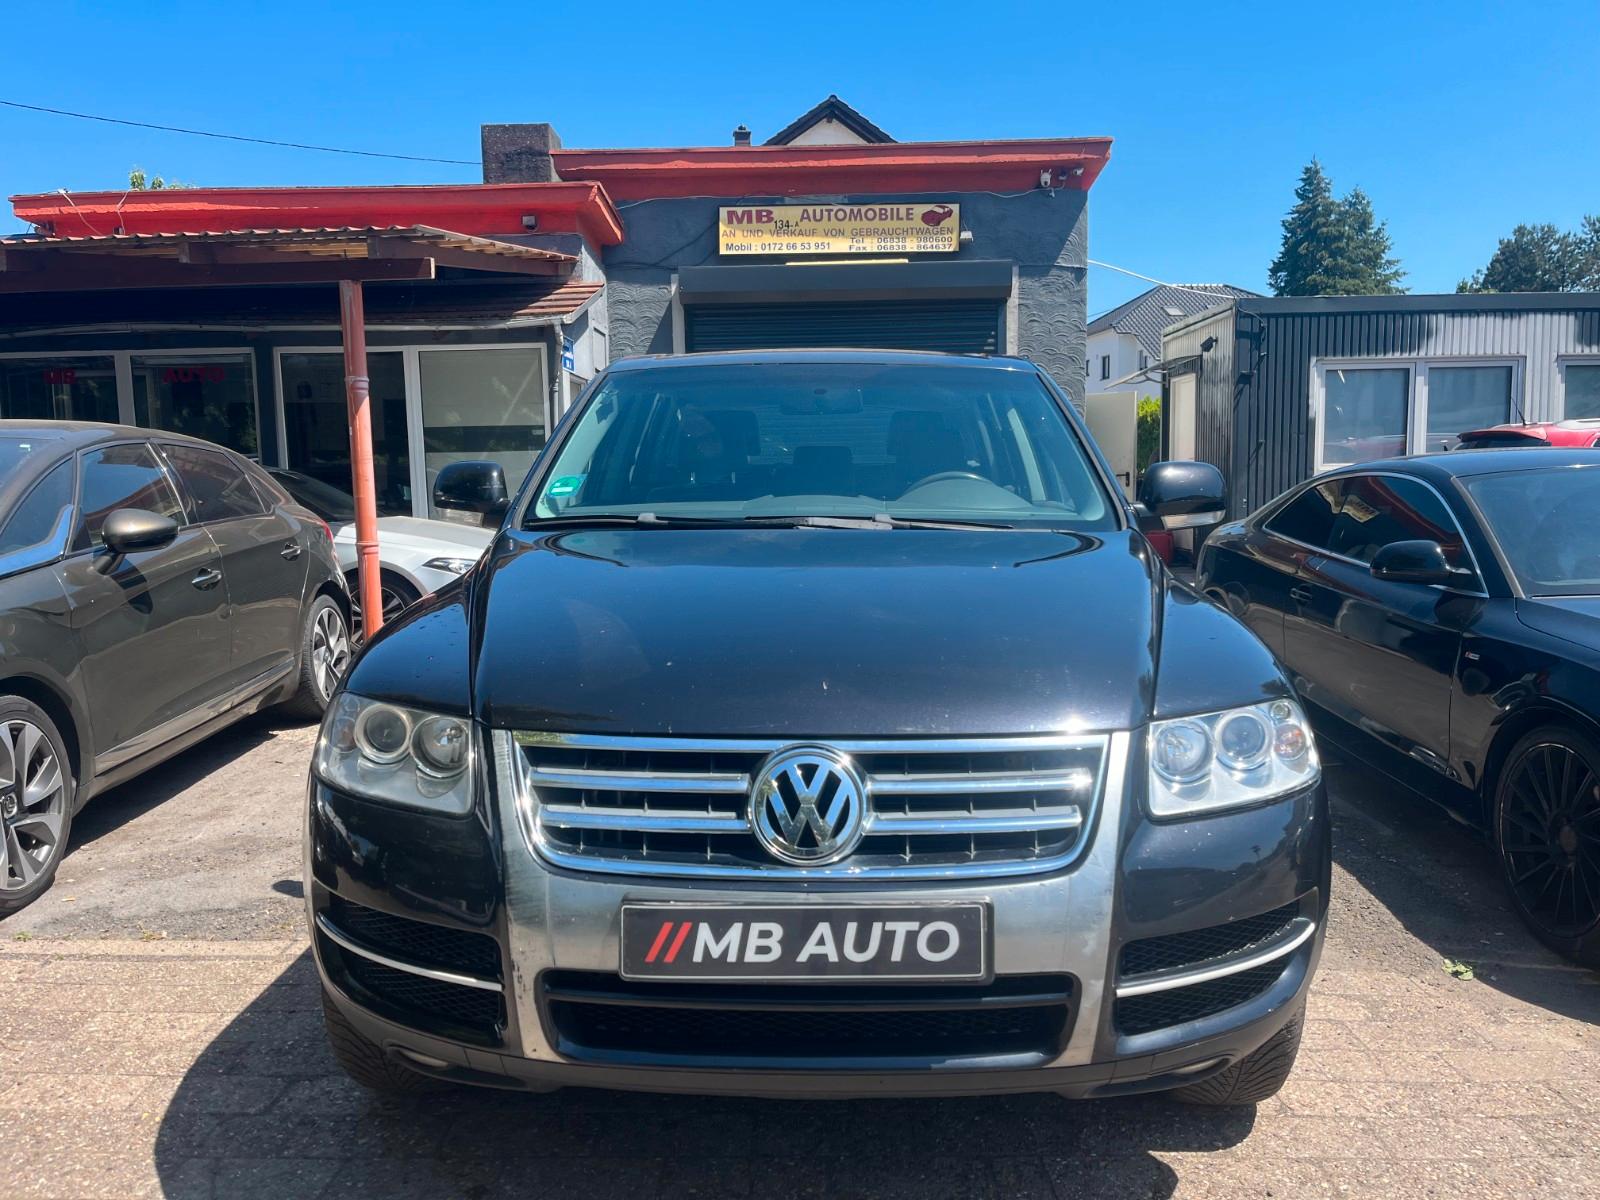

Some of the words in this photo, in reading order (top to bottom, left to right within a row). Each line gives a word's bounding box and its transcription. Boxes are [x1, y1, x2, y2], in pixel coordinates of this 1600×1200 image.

[726, 209, 775, 225] MB
[800, 207, 914, 222] AUTOMOBILE
[721, 229, 736, 238] AN
[742, 229, 764, 238] UND
[769, 228, 817, 238] VERKAUF
[823, 228, 845, 237] VON
[850, 226, 954, 237] GEBRAUCHTWAGEN
[760, 242, 784, 251] 0172
[785, 242, 798, 251] 66
[800, 242, 812, 250] 53
[814, 242, 831, 250] 951
[877, 236, 907, 244] 06838
[162, 367, 225, 385] AUTO
[795, 920, 960, 963] AUTO
